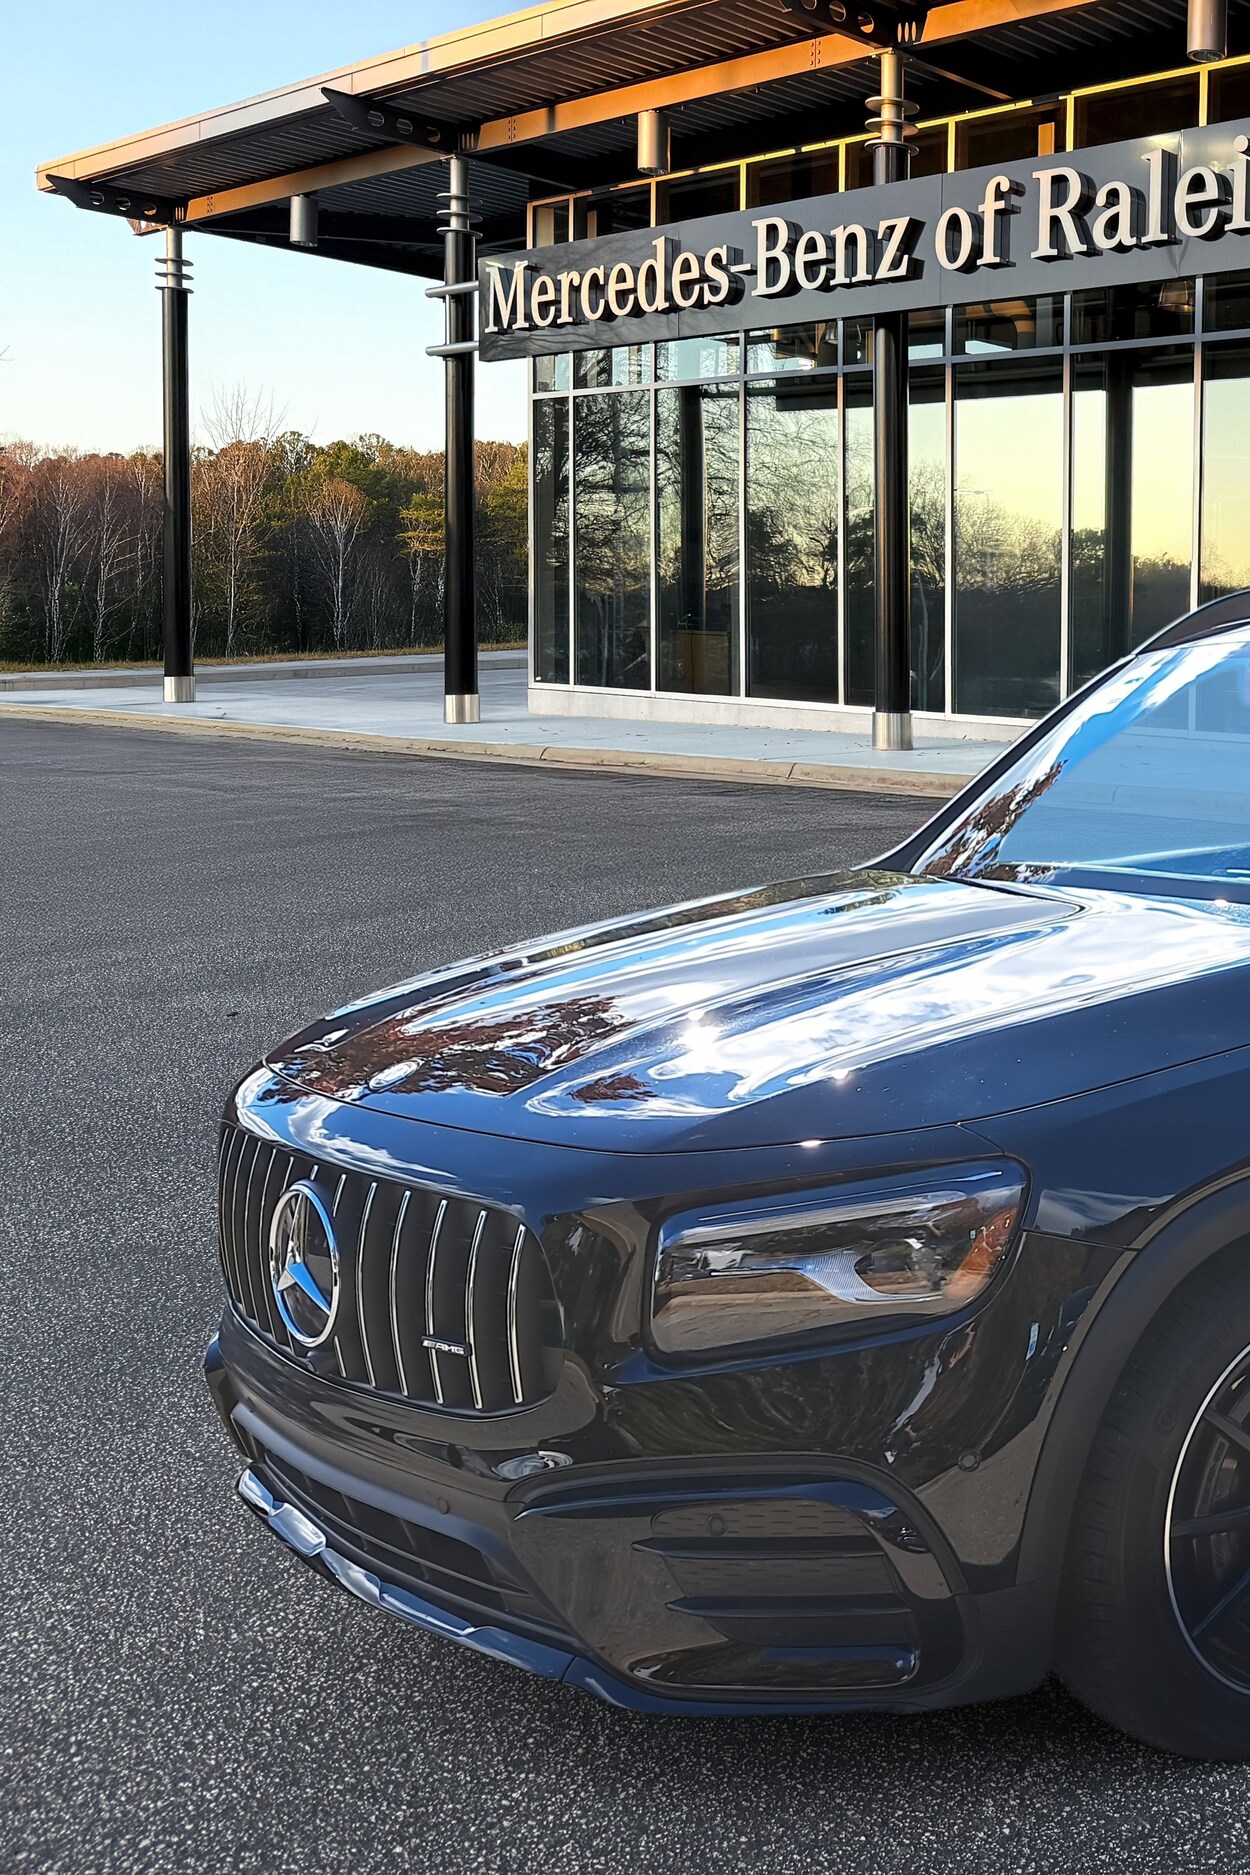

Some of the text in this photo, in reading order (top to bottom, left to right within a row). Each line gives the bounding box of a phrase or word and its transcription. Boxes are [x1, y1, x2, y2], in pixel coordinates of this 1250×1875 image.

[484, 216, 914, 334] Mercedes-Benz
[933, 175, 1014, 271] of
[434, 1342, 465, 1355] AMG
